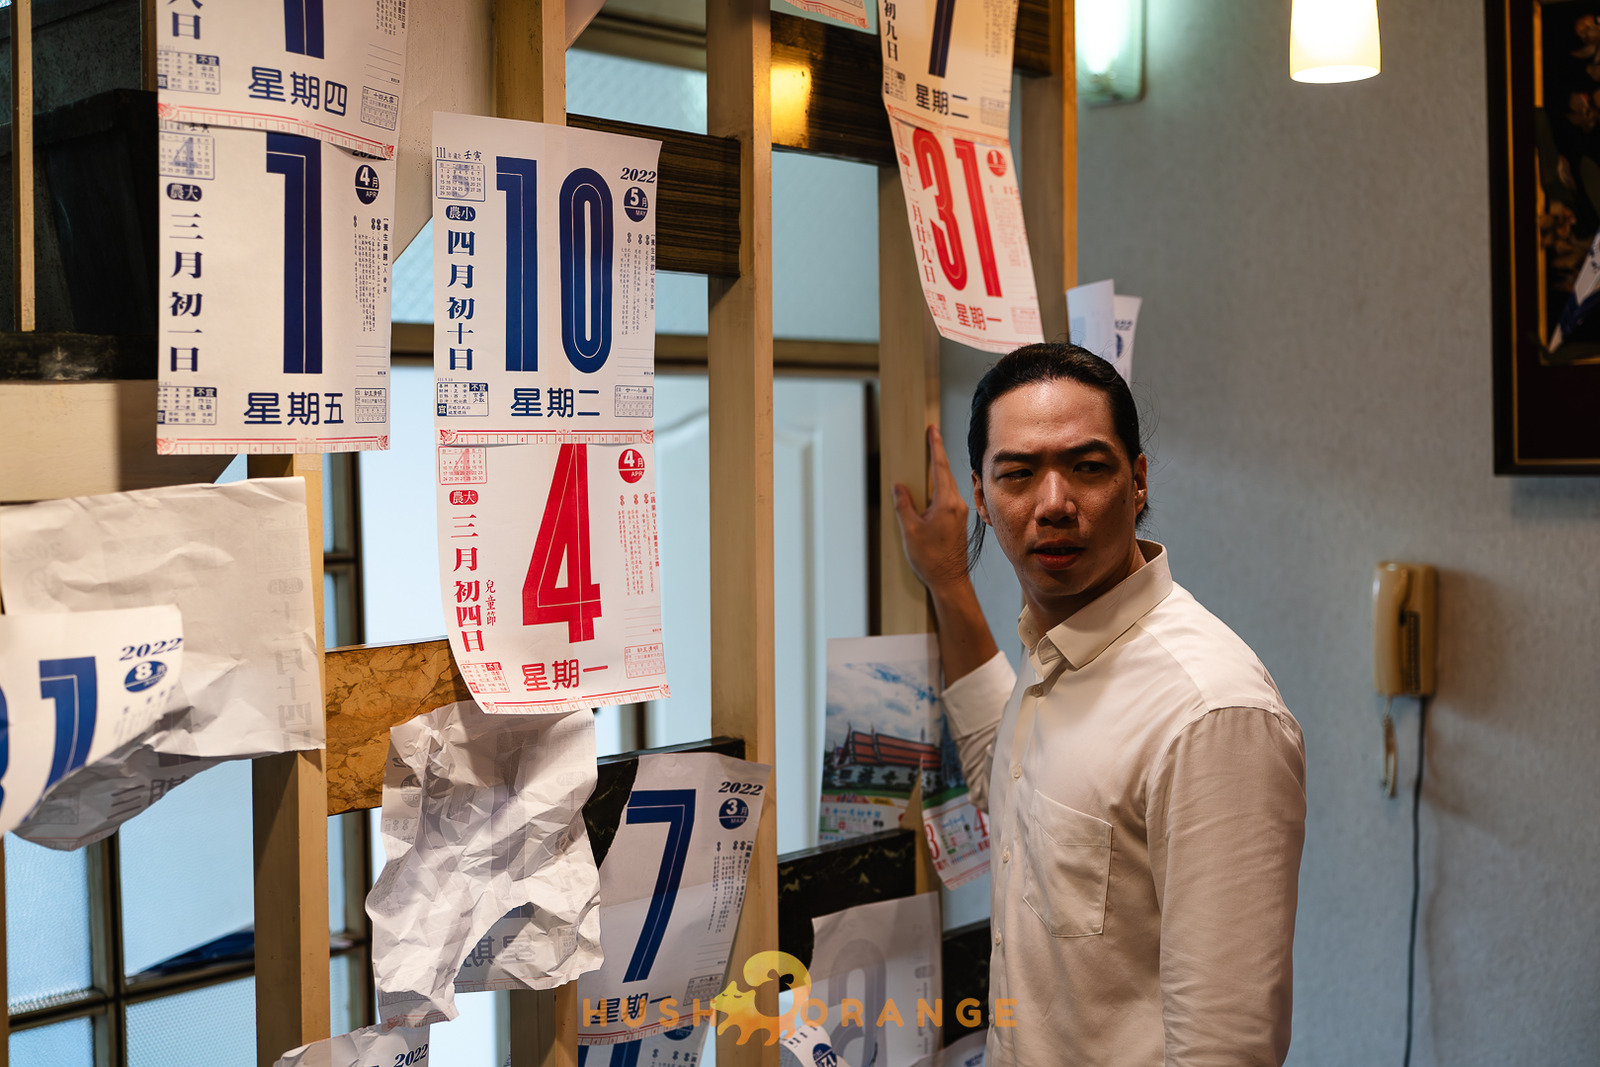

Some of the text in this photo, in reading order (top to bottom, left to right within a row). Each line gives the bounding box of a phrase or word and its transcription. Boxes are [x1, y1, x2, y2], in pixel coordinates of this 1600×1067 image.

[248, 66, 348, 117] 星期四
[915, 83, 969, 119] 星期二
[360, 167, 378, 188] 4月
[620, 167, 656, 184] 2022
[630, 188, 647, 207] 5月
[912, 127, 1003, 299] 31
[266, 131, 323, 374] 1
[496, 156, 613, 374] 10
[168, 213, 204, 372] 三月初一日
[447, 229, 476, 371] 四月初十日
[955, 302, 1002, 331] 星期一
[243, 391, 344, 426] 星期五
[511, 387, 600, 418] 星期二
[624, 450, 644, 467] 4月
[522, 443, 602, 643] 4
[450, 513, 485, 652] 三月初四日
[485, 579, 497, 627] 兒童節
[119, 637, 183, 661] 2022
[521, 659, 608, 692] 星期一
[718, 781, 763, 796] 2022
[726, 799, 747, 816] 3月
[622, 789, 696, 983] 7
[590, 992, 672, 1025] 星期一
[393, 1043, 429, 1067] 2022
